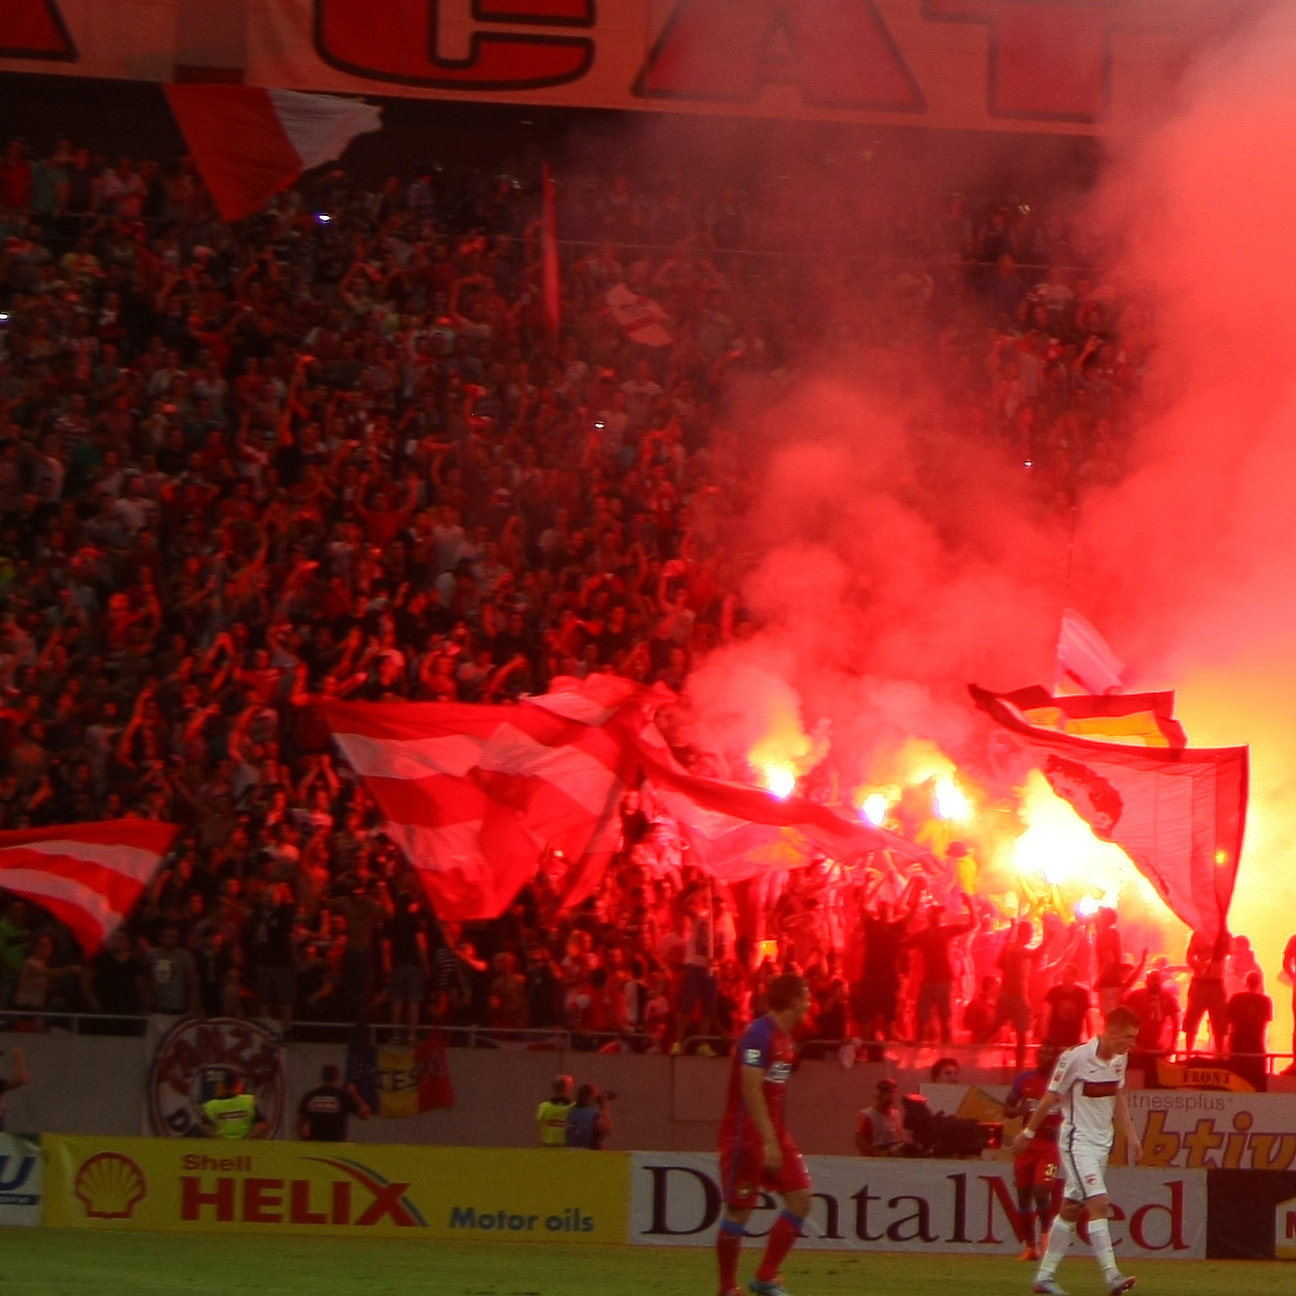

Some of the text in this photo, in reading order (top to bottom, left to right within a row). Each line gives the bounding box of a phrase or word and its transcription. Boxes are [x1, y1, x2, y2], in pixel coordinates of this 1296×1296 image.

[1183, 1070, 1230, 1084] FRONT
[1127, 1091, 1227, 1113] itnessplus
[183, 1152, 253, 1173] Shell
[180, 1176, 427, 1228] HELIX
[641, 1165, 1191, 1252] DentalMed
[450, 1206, 595, 1233] Motor oils
